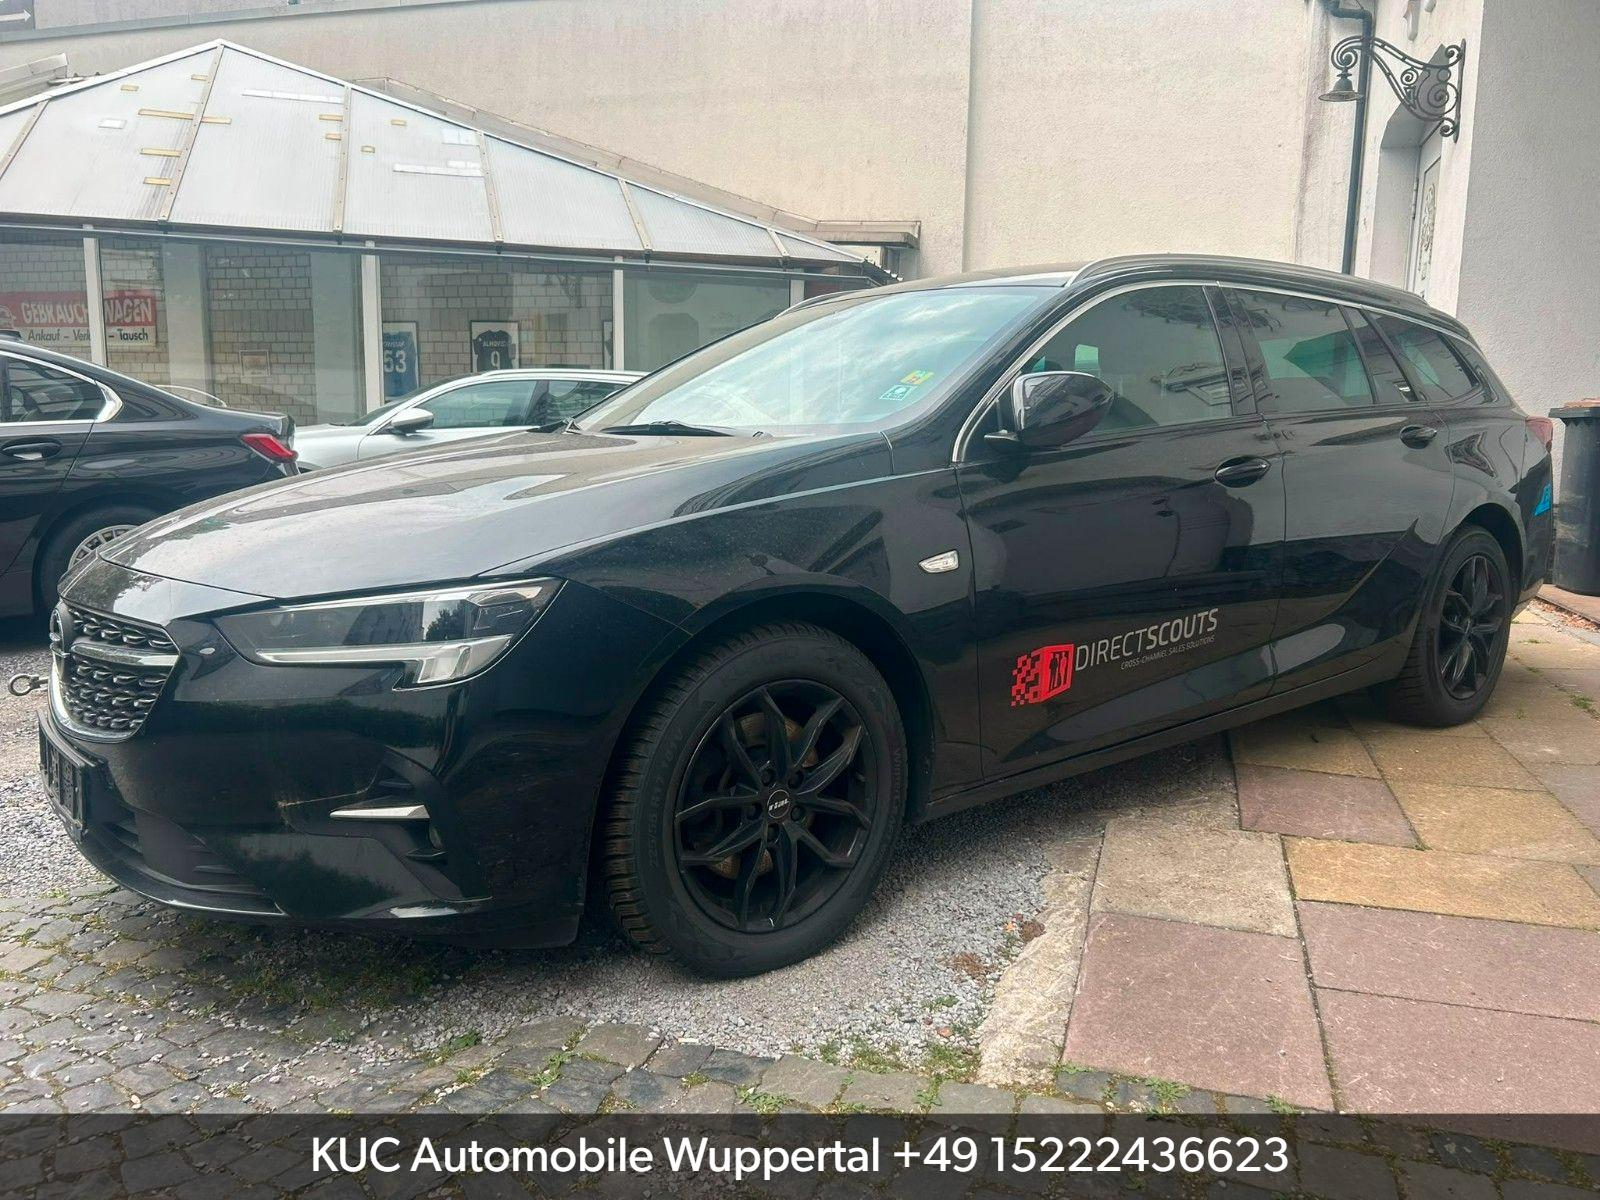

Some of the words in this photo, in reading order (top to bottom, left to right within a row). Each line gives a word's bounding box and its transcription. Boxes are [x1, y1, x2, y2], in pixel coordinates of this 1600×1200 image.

[28, 328, 61, 341] Ankauf
[117, 328, 149, 341] Tausch
[383, 349, 407, 373] 53
[1075, 608, 1219, 671] DIRECTSCOUTS
[1121, 648, 1168, 670] CROSS-CHANNEL
[1169, 643, 1186, 656] SALES
